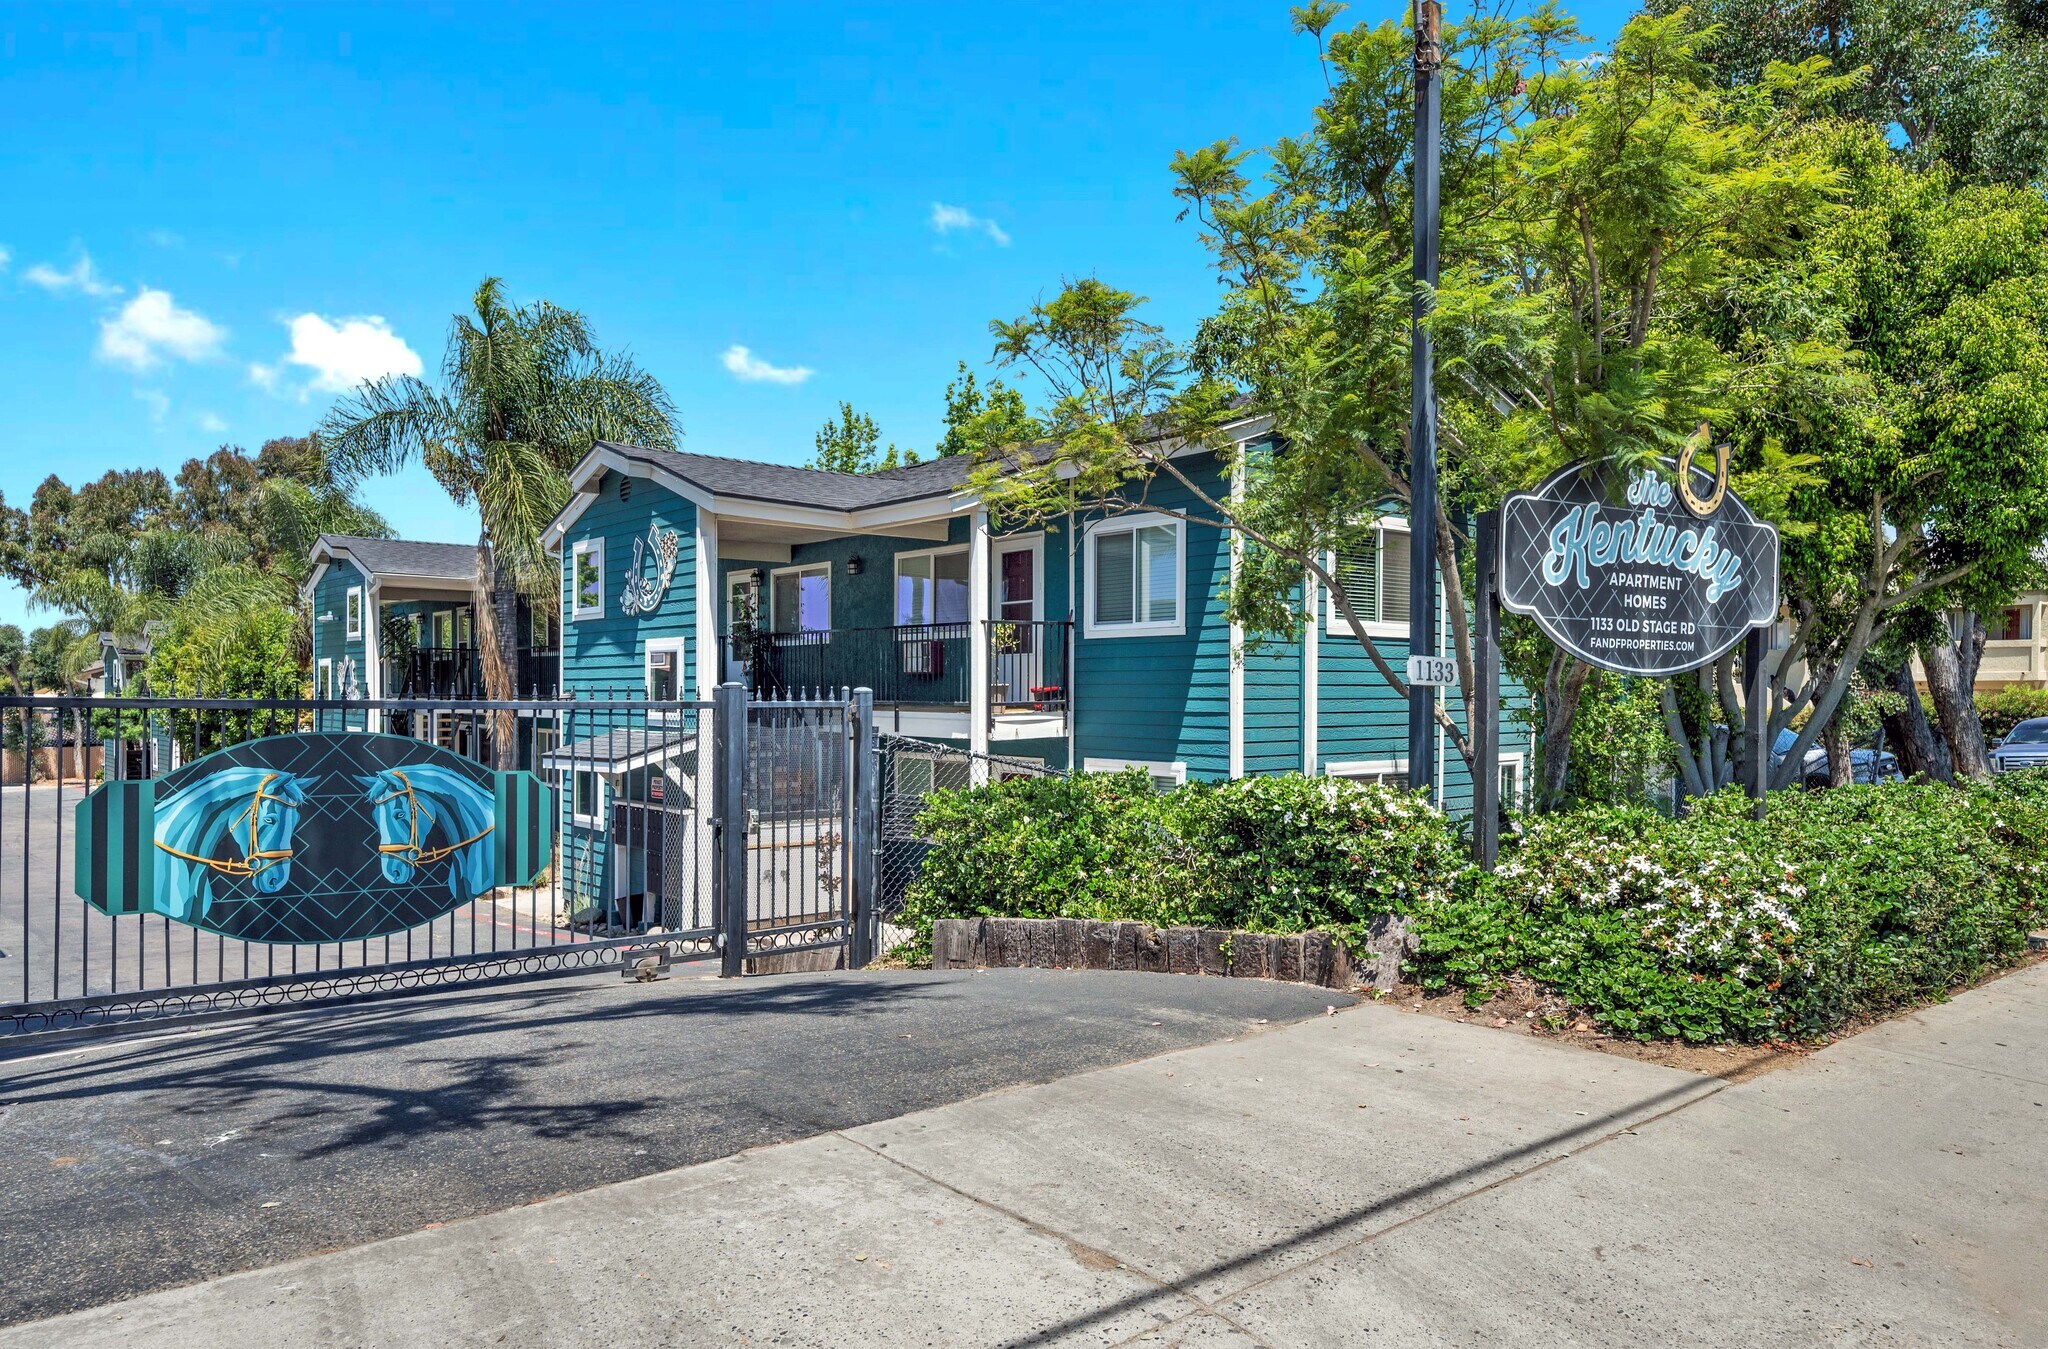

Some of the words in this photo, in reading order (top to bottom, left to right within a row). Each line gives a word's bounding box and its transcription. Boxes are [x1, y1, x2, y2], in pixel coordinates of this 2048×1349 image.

[1542, 502, 1742, 604] Kentucky
[1609, 572, 1683, 591] APARTMENT
[1624, 593, 1667, 610] HOMES
[1590, 617, 1614, 631] 1133
[1616, 618, 1640, 632] OLD
[1642, 619, 1678, 634] STAGE
[1680, 621, 1696, 635] RD
[1590, 637, 1695, 652] FANDFPROPERTIES.COM
[1416, 659, 1454, 683] 1133
